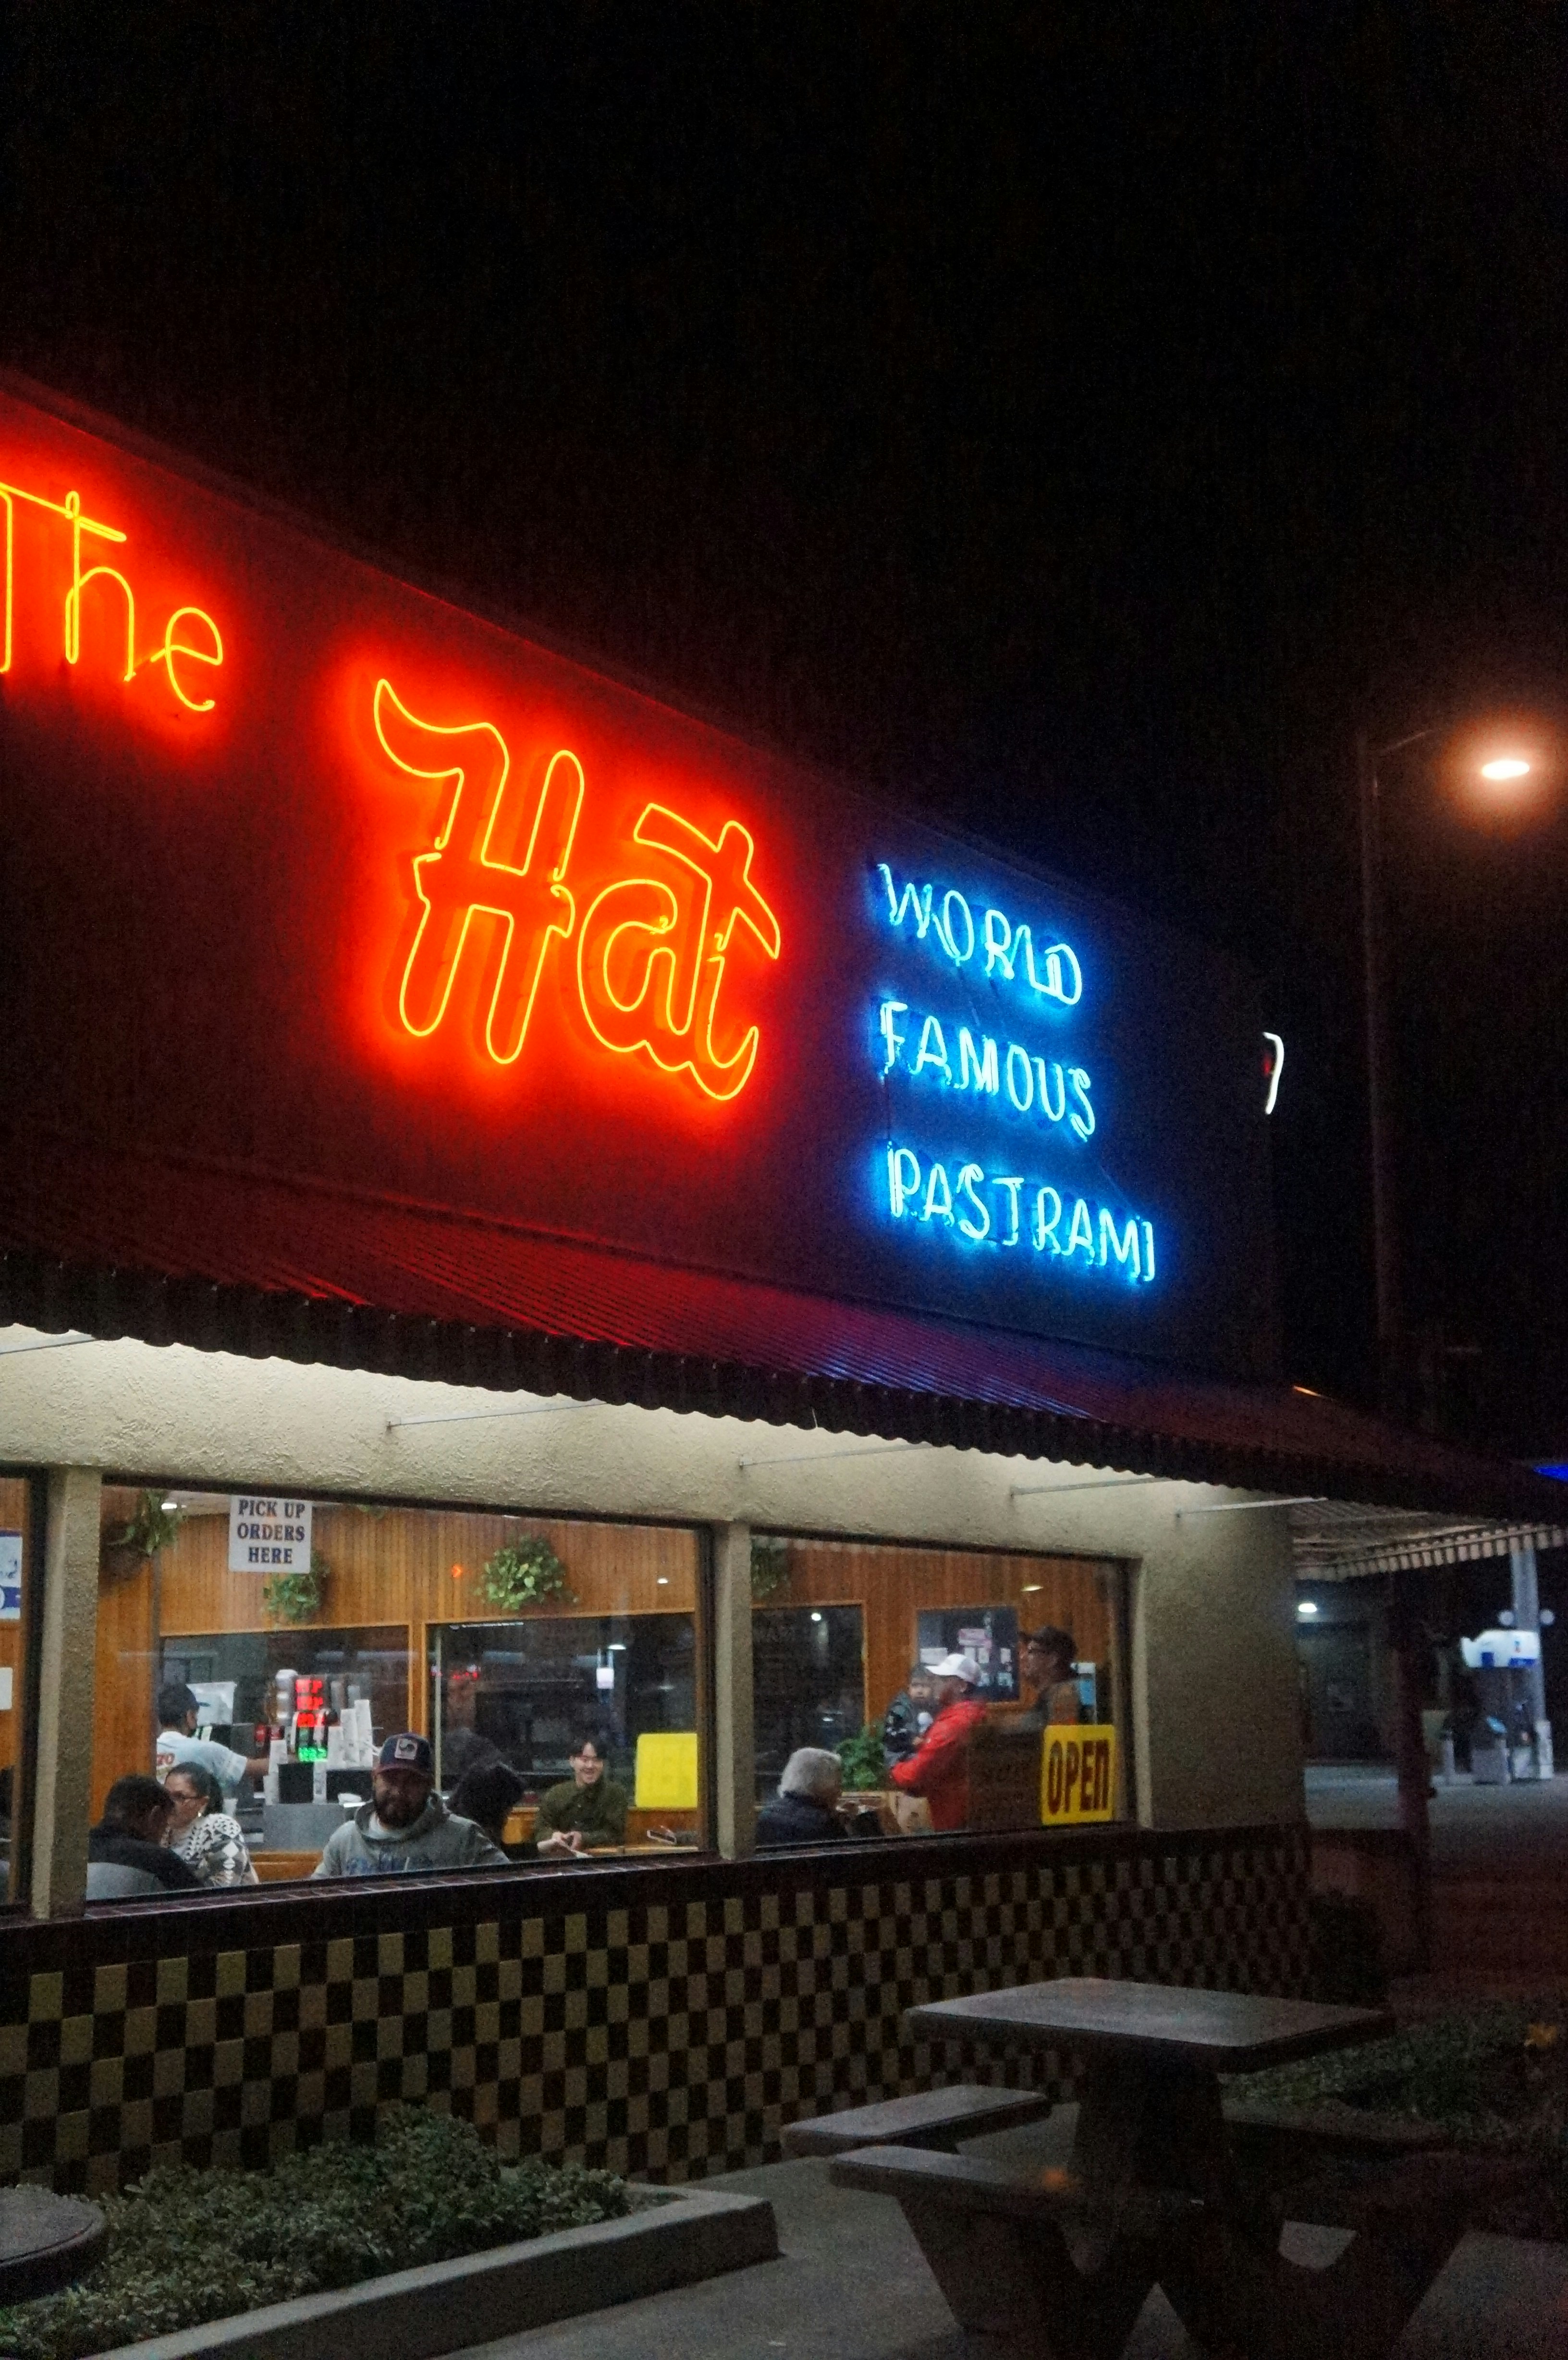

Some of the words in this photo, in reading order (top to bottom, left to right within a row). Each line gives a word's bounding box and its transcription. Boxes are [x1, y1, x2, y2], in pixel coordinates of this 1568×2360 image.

[0, 482, 224, 712] The
[374, 679, 780, 1101] Hat
[877, 863, 1083, 1006] WORLD
[880, 1001, 1096, 1143] FAMOUS
[887, 1144, 1155, 1282] PASTRAMI
[237, 1522, 306, 1542] ORDERS
[238, 1499, 278, 1518] PICK
[284, 1501, 306, 1519] UP
[248, 1547, 293, 1564] HERE
[1046, 1739, 1110, 1816] OPEN
